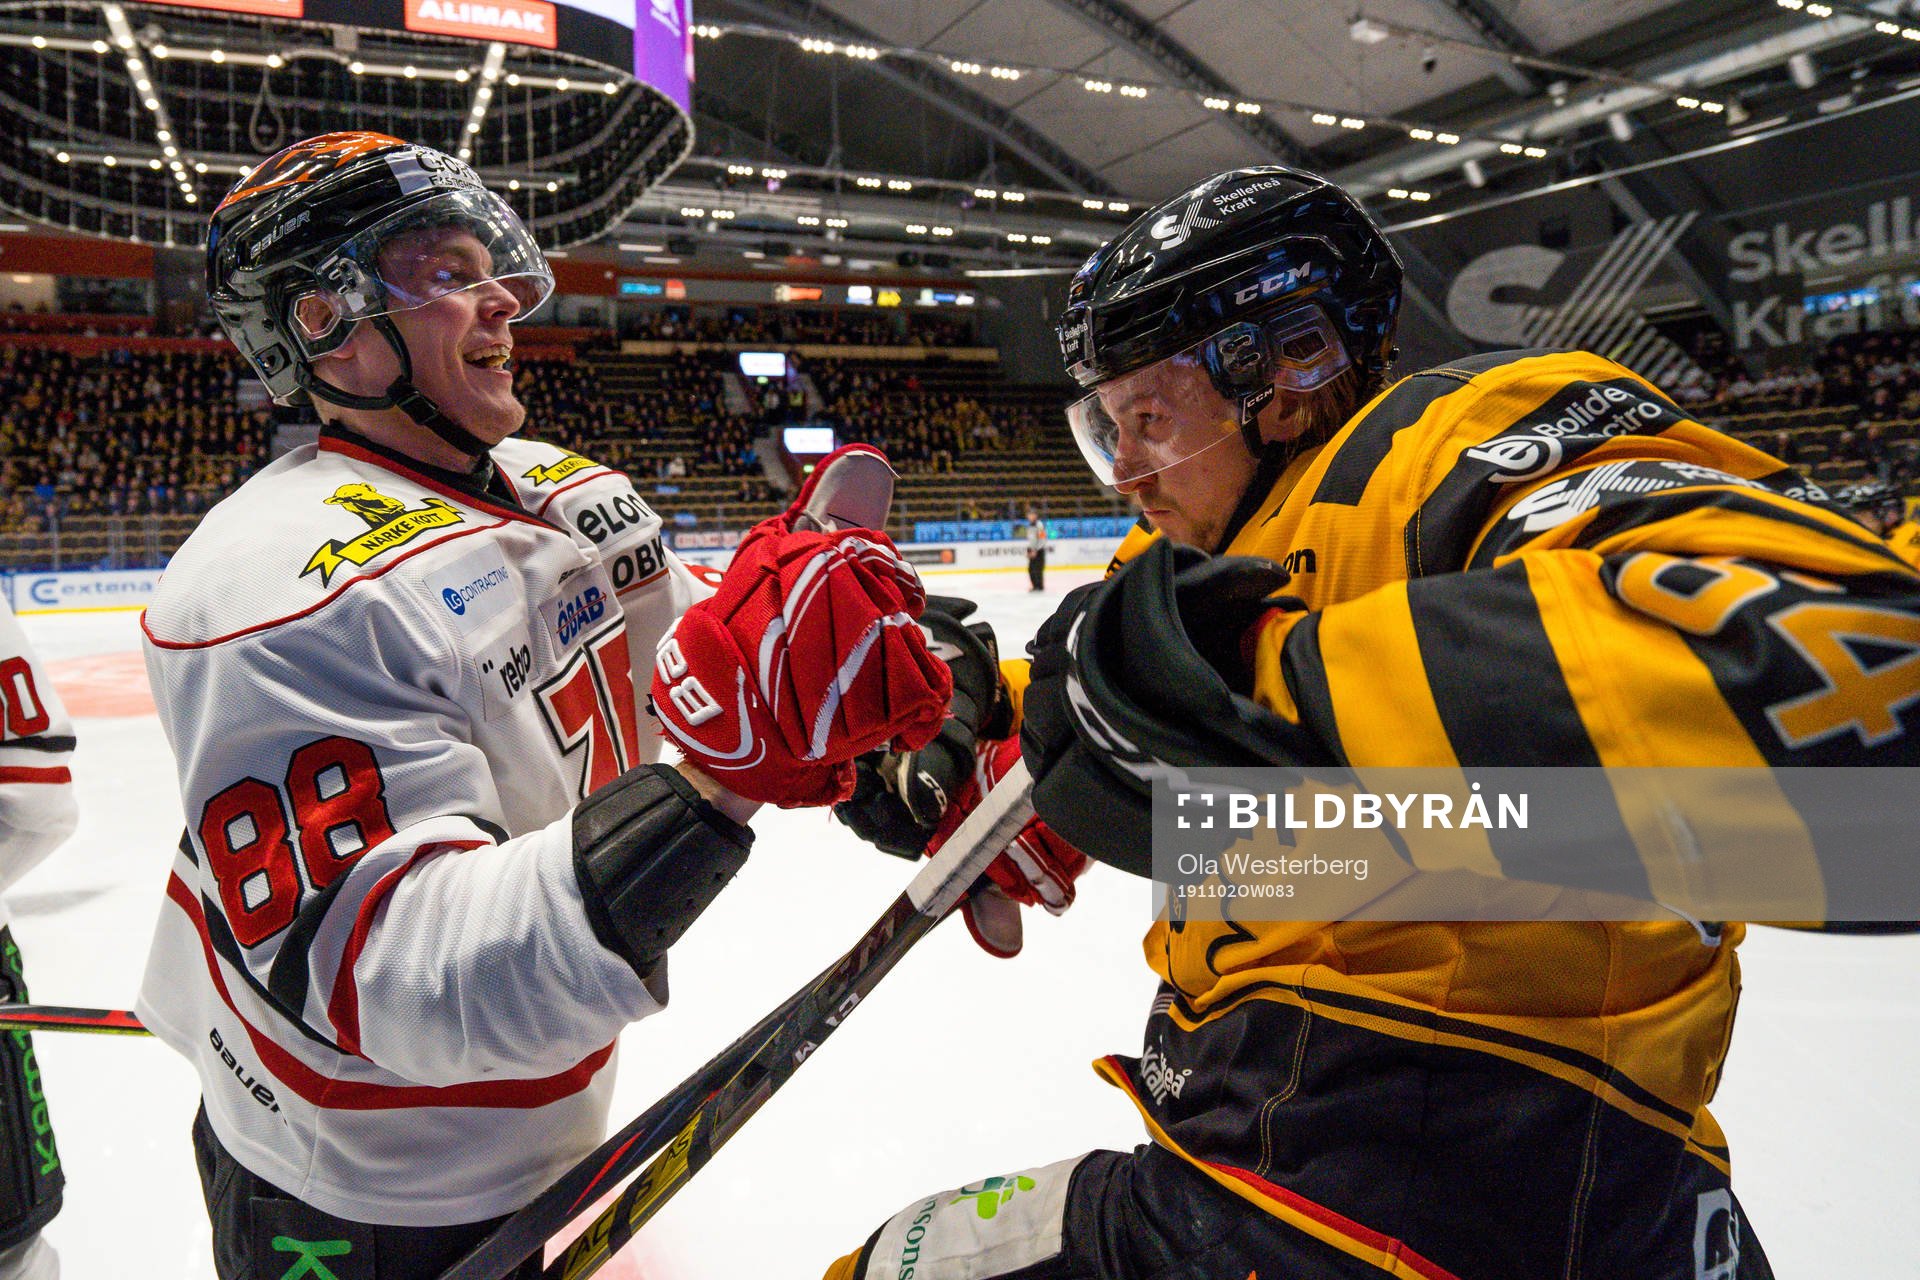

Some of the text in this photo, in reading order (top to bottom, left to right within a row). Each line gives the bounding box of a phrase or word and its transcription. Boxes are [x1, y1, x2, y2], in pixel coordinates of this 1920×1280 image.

[417, 0, 545, 33] ALIMAK
[1212, 177, 1281, 206] Skellefteå
[1219, 197, 1257, 216] Kraft
[1727, 196, 1920, 282] Skell
[1234, 261, 1311, 305] CCM
[1247, 388, 1273, 408] CCM
[360, 511, 444, 551] NÄRKE KÖTT
[61, 580, 154, 596] extena
[445, 593, 463, 610] LG
[557, 586, 605, 646] ÖBAB
[198, 735, 397, 950] 88
